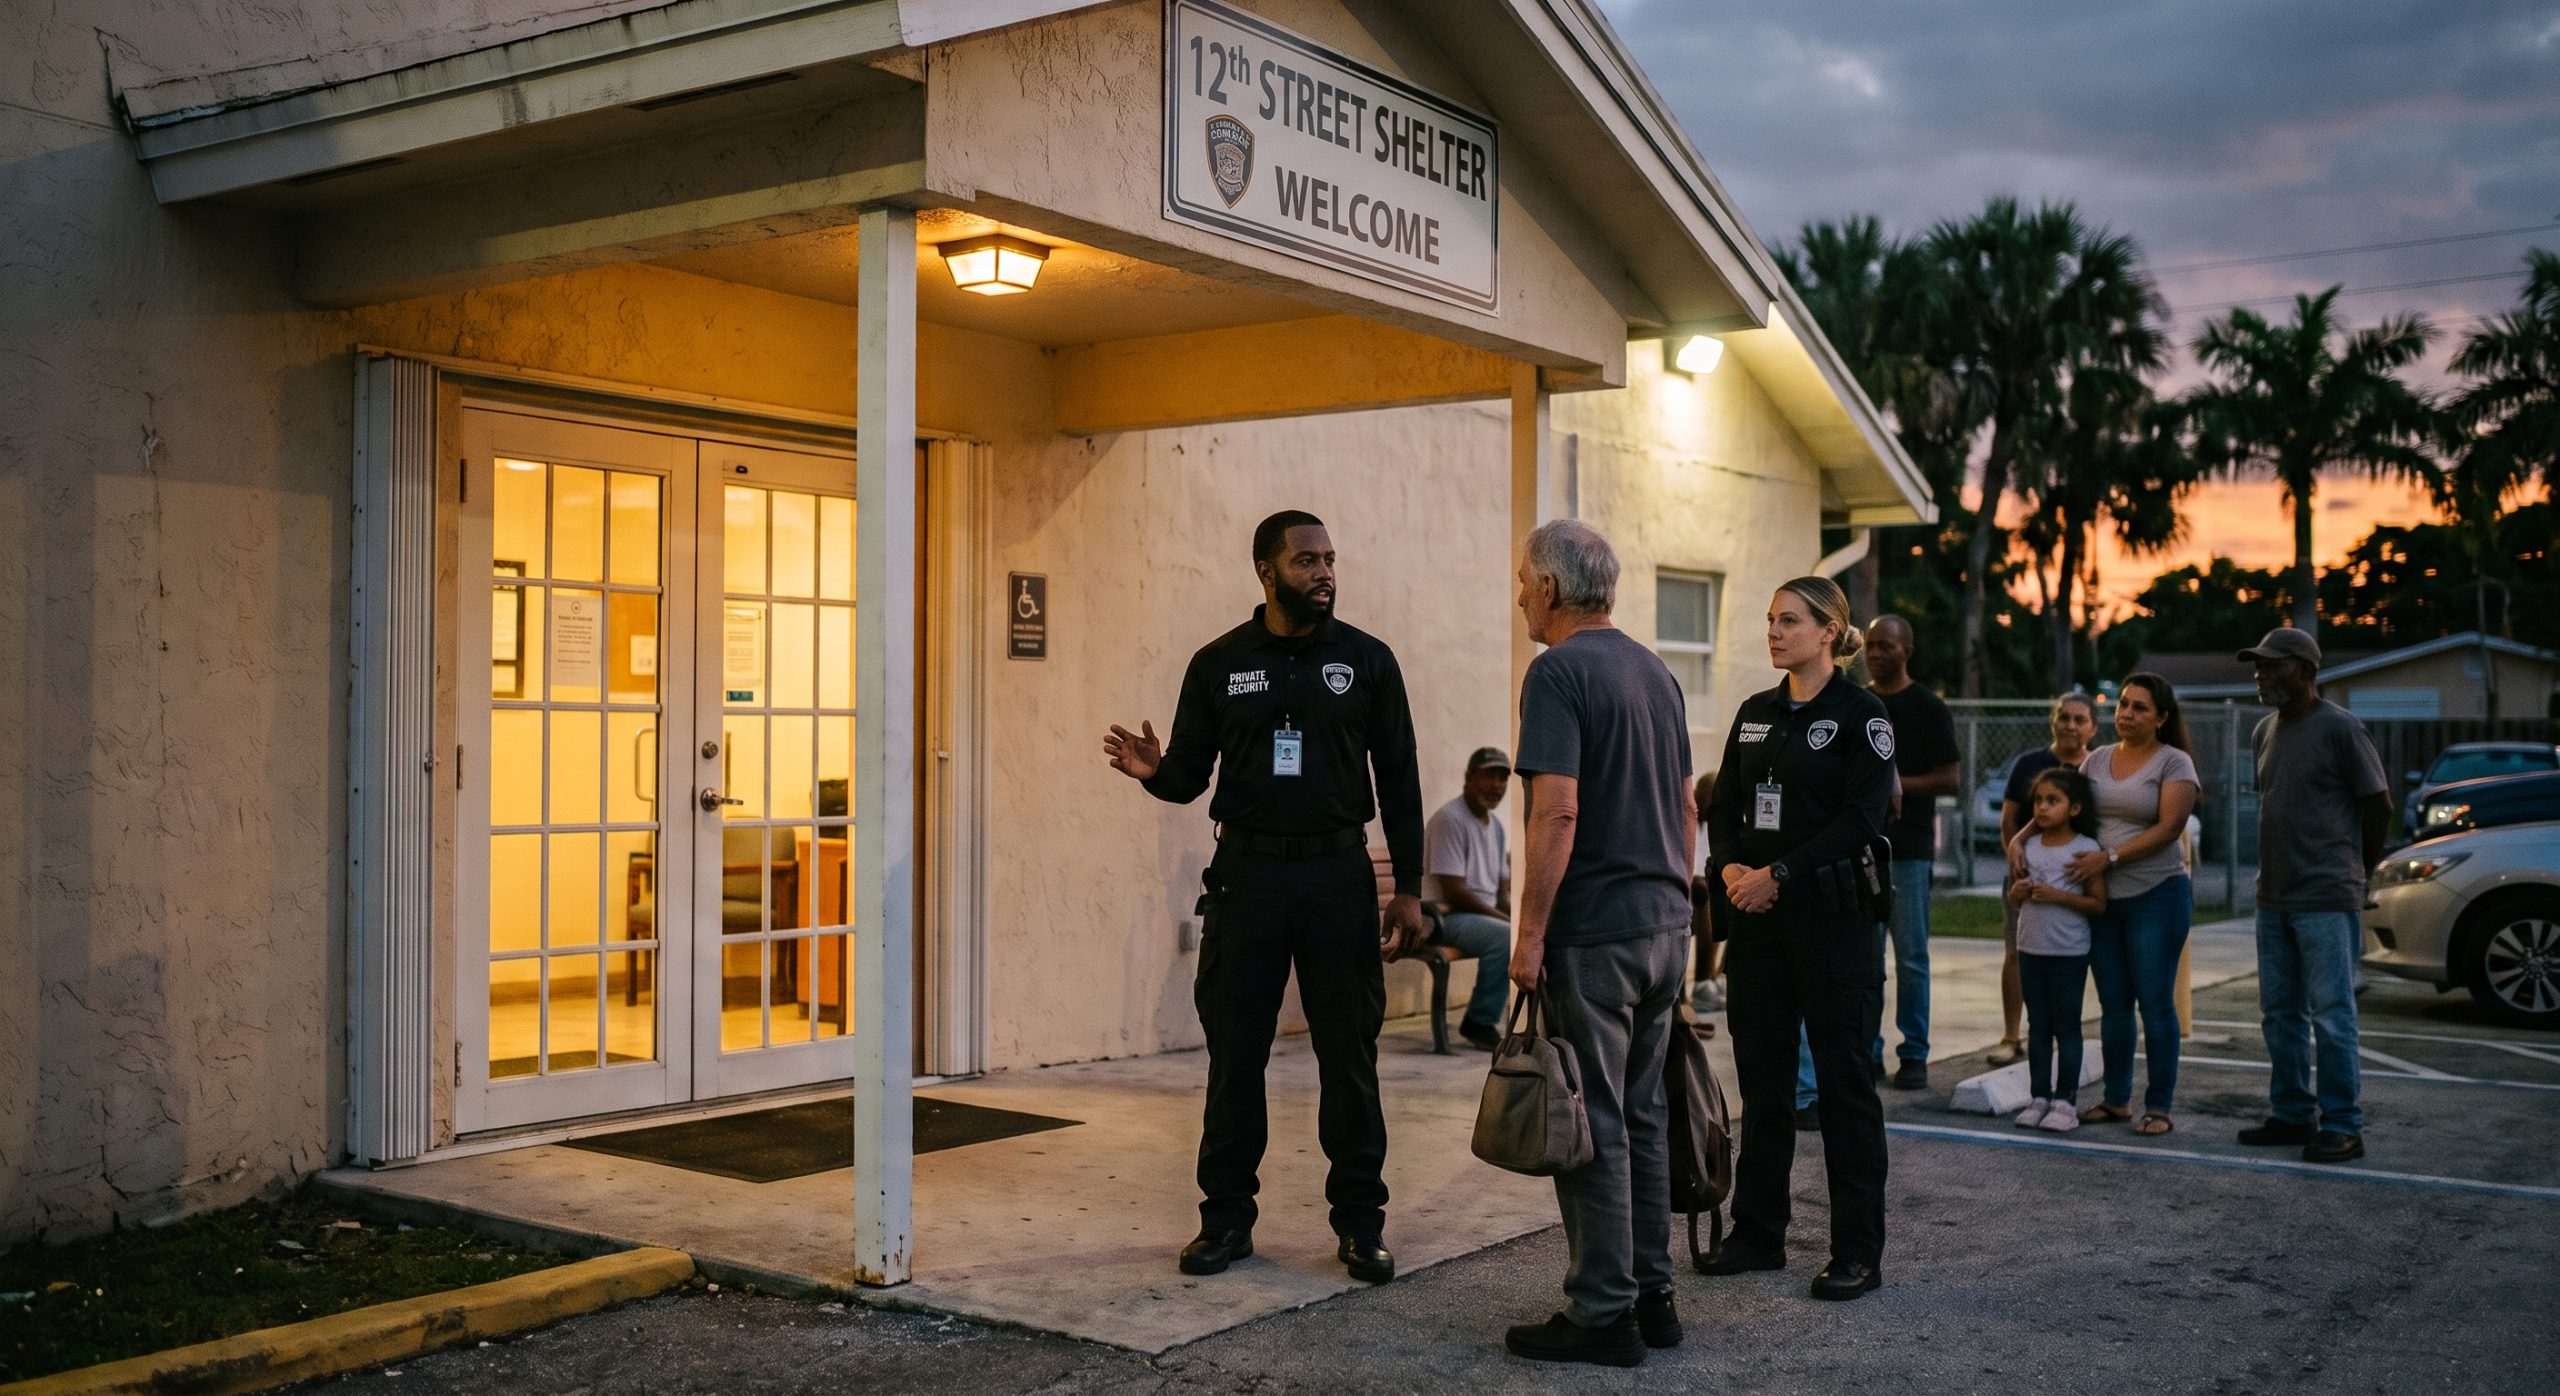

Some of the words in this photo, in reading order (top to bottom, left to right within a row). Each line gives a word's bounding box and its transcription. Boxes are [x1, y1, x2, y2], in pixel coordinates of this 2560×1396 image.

[1190, 35, 1250, 105] 12th
[1259, 59, 1367, 154] STREET
[1374, 105, 1487, 202] SHELTER
[1275, 165, 1440, 266] WELCOME
[1228, 681, 1269, 696] SECURITY
[1230, 670, 1266, 684] PRIVATE
